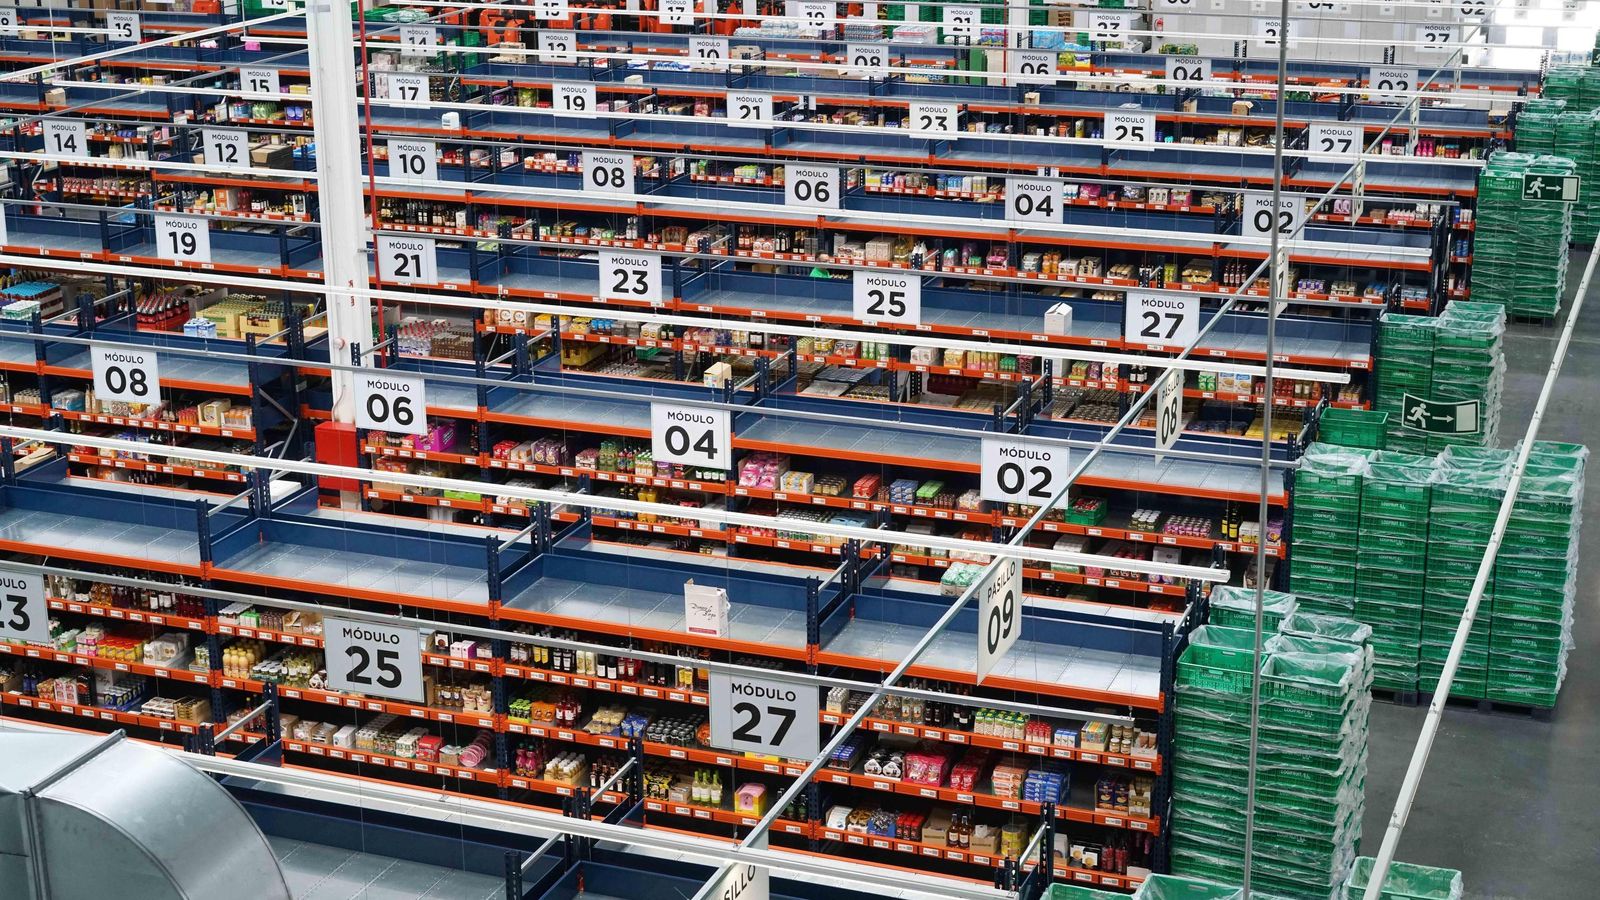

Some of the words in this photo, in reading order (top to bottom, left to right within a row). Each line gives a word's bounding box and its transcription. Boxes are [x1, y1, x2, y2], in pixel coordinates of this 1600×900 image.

[1461, 1, 1485, 15] 02
[1097, 22, 1119, 37] 23
[696, 40, 720, 48] MÓDULO
[1425, 33, 1449, 48] 27
[548, 43, 566, 58] 12
[1173, 66, 1203, 81] 04
[399, 87, 418, 100] 17
[564, 95, 585, 110] 19
[740, 105, 760, 120] 21
[920, 115, 947, 130] 23
[1115, 126, 1143, 141] 25
[1320, 128, 1352, 136] MÓDULO
[54, 133, 77, 152] 14
[398, 144, 426, 152] MÓDULO
[1321, 138, 1352, 152] 27
[215, 143, 238, 163] 12
[592, 156, 624, 164] MÓDULO
[399, 154, 425, 174] 10
[593, 166, 625, 188] 08
[796, 170, 828, 178] MÓDULO
[795, 180, 829, 202] 06
[1018, 184, 1052, 192] MÓDULO
[1015, 194, 1053, 216] 04
[166, 221, 197, 229] MÓDULO
[1254, 209, 1293, 233] 02
[169, 232, 196, 255] 19
[389, 241, 423, 250] MÓDULO
[394, 253, 421, 277] 21
[612, 258, 648, 266] MÓDULO
[613, 269, 648, 294] 23
[867, 278, 906, 287] MÓDULO
[867, 290, 905, 317] 25
[1142, 299, 1184, 309] MÓDULO
[1141, 311, 1183, 338] 27
[105, 352, 143, 364] MÓDULO
[106, 366, 148, 396] 08
[368, 380, 409, 392] MÓDULO
[367, 394, 413, 425] 06
[668, 411, 714, 424] MÓDULO
[1161, 396, 1178, 445] 08
[665, 426, 717, 459] 04
[1000, 447, 1051, 461] MÓDULO
[997, 463, 1052, 498] 02
[987, 560, 1016, 604] PASILLO
[0, 594, 30, 631] 3
[987, 590, 1014, 655] 09
[343, 627, 400, 644] MÓDULO
[345, 646, 401, 688] 25
[732, 682, 797, 702] MÓDULO
[733, 702, 796, 746] 27
